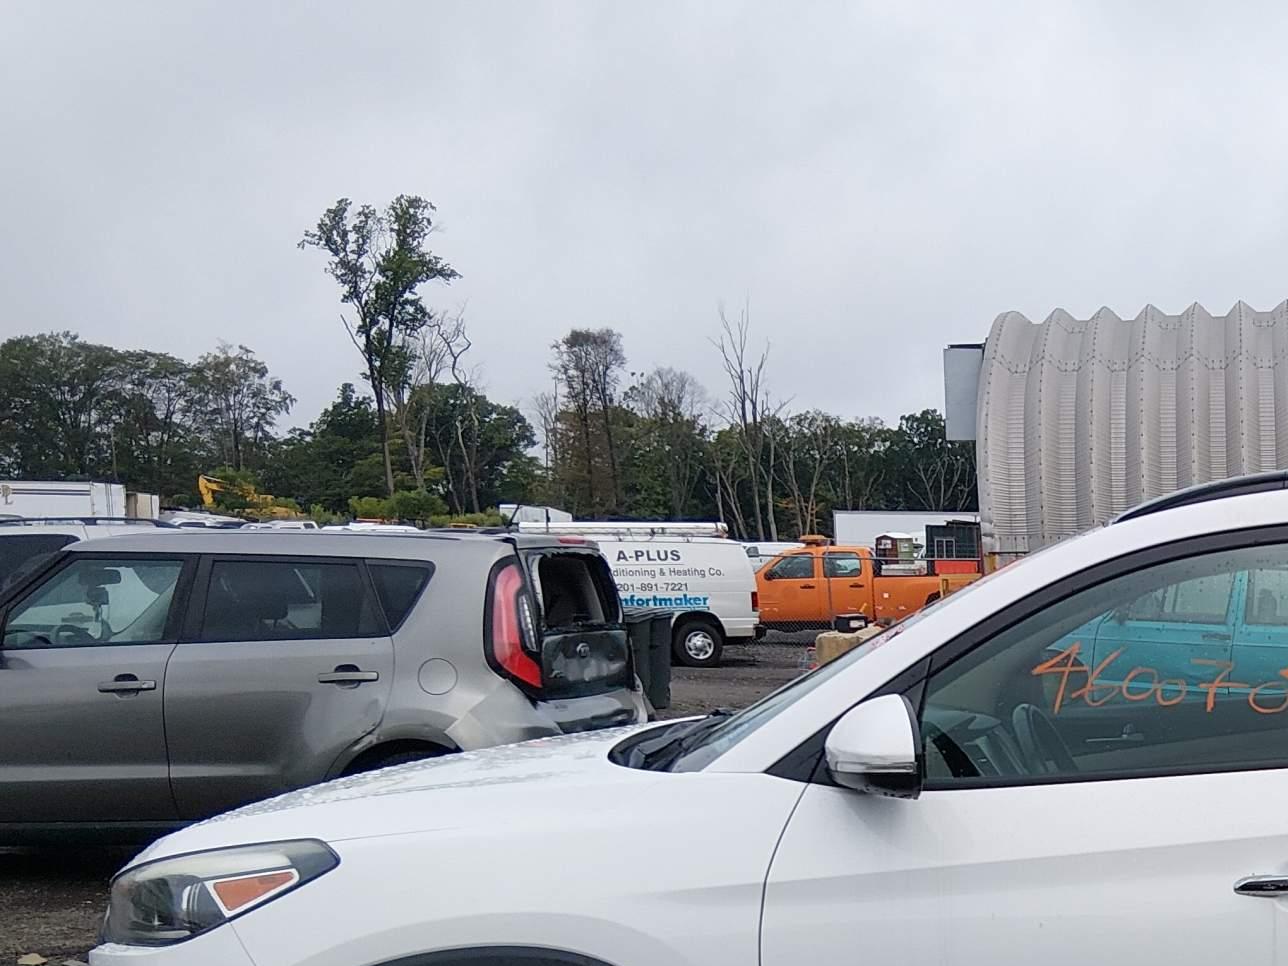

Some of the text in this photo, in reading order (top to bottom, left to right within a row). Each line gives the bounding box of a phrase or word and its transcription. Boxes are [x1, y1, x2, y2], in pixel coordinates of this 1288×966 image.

[616, 549, 681, 562] A-PLUS
[659, 568, 666, 577] &
[669, 567, 706, 579] Heating
[708, 567, 725, 577] Co.
[617, 582, 688, 592] 201-891-7221
